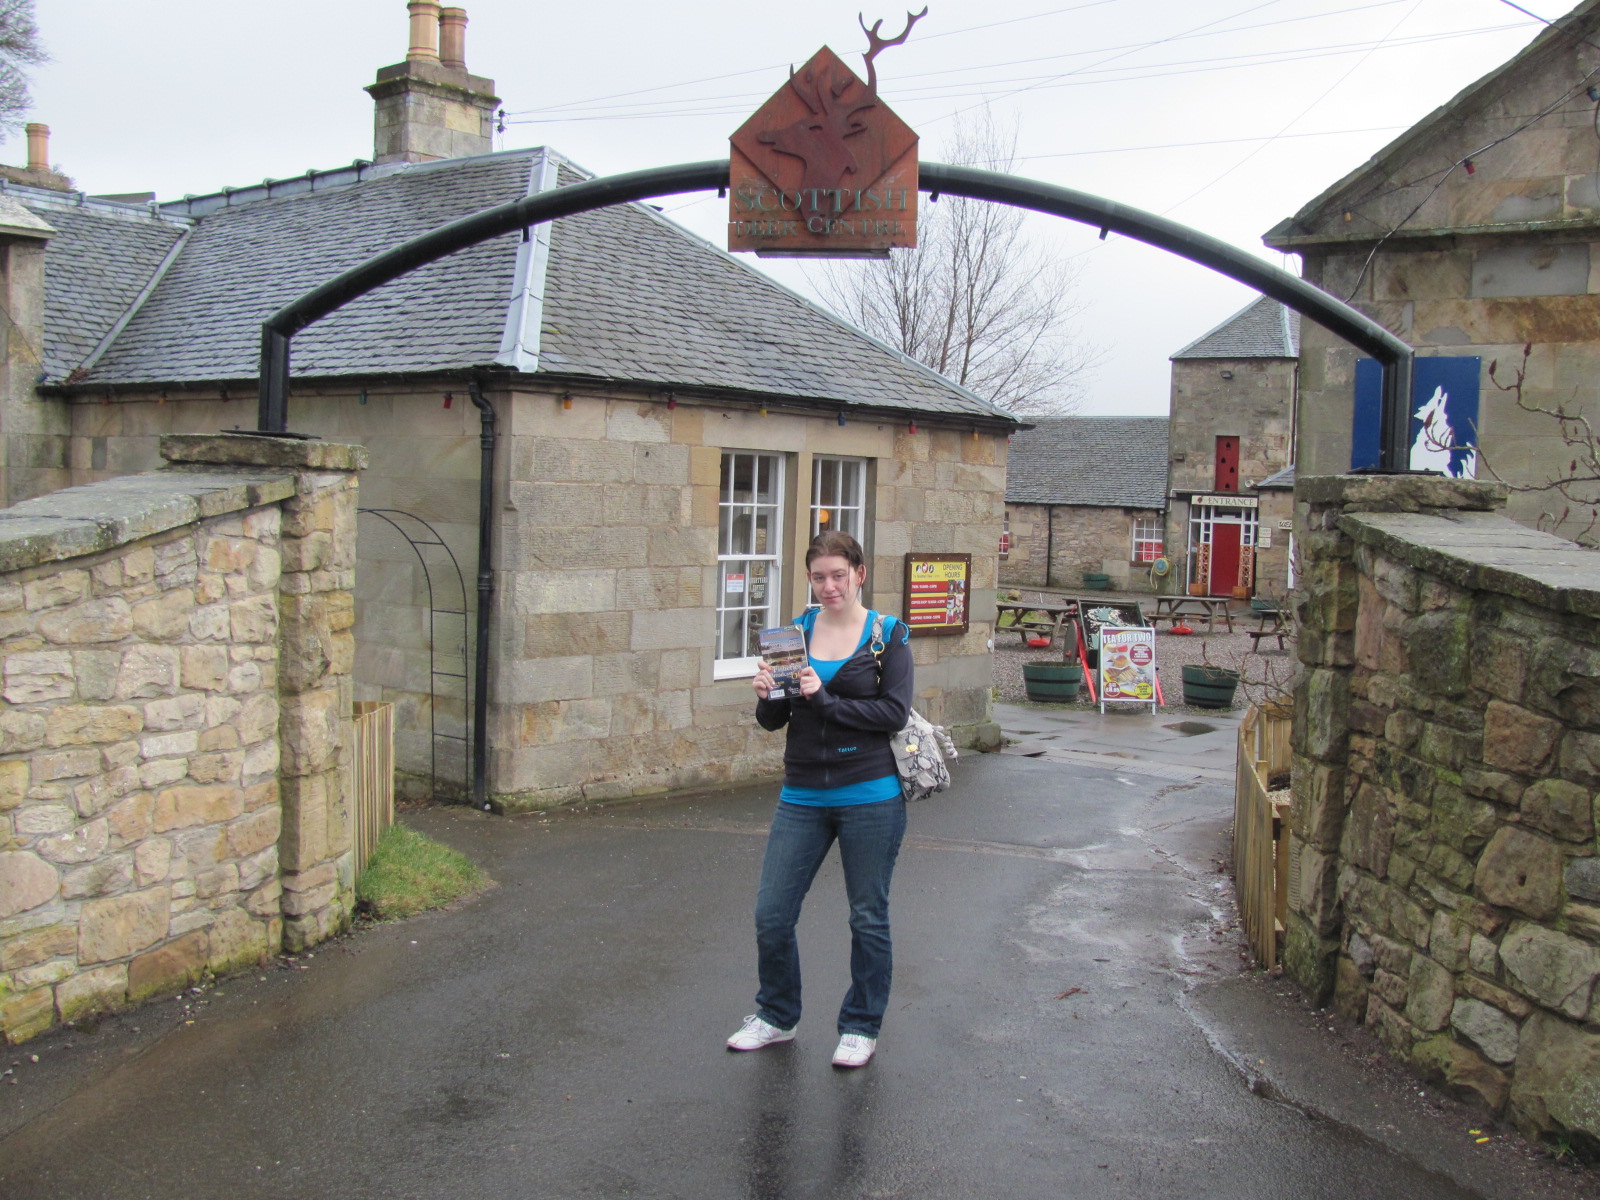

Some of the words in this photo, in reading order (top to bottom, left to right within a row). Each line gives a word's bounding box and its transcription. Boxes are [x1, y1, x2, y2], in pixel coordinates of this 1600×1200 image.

[735, 188, 907, 212] SCOTTISH
[736, 220, 797, 236] DEER
[806, 216, 906, 237] CENTRE
[1208, 497, 1254, 506] ENTRANCE
[1103, 634, 1116, 644] TEA
[1117, 634, 1132, 643] FOR
[1133, 632, 1151, 642] TWO
